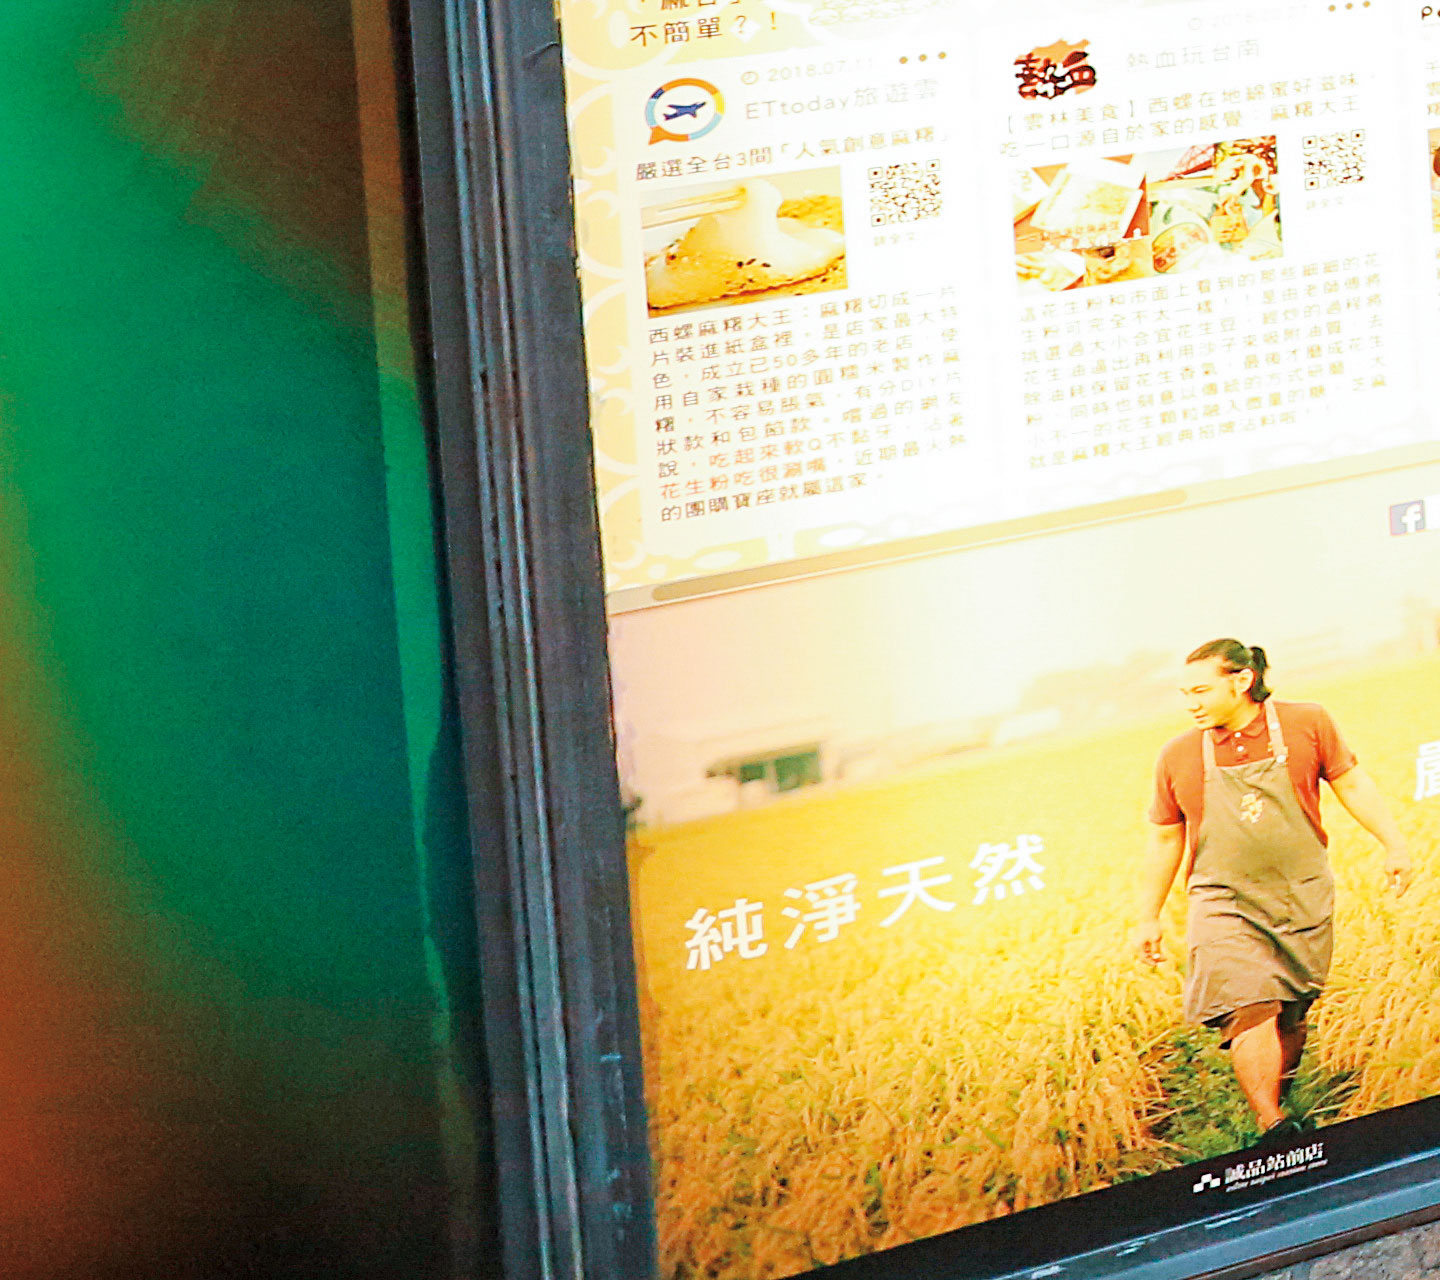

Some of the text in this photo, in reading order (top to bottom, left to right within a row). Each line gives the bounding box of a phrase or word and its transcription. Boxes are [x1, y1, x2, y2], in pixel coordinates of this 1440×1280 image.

[745, 77, 939, 121] ETtoday旅遊雲
[684, 833, 1049, 975] 純淨天然
[1224, 1142, 1324, 1185] 誠品站前店
